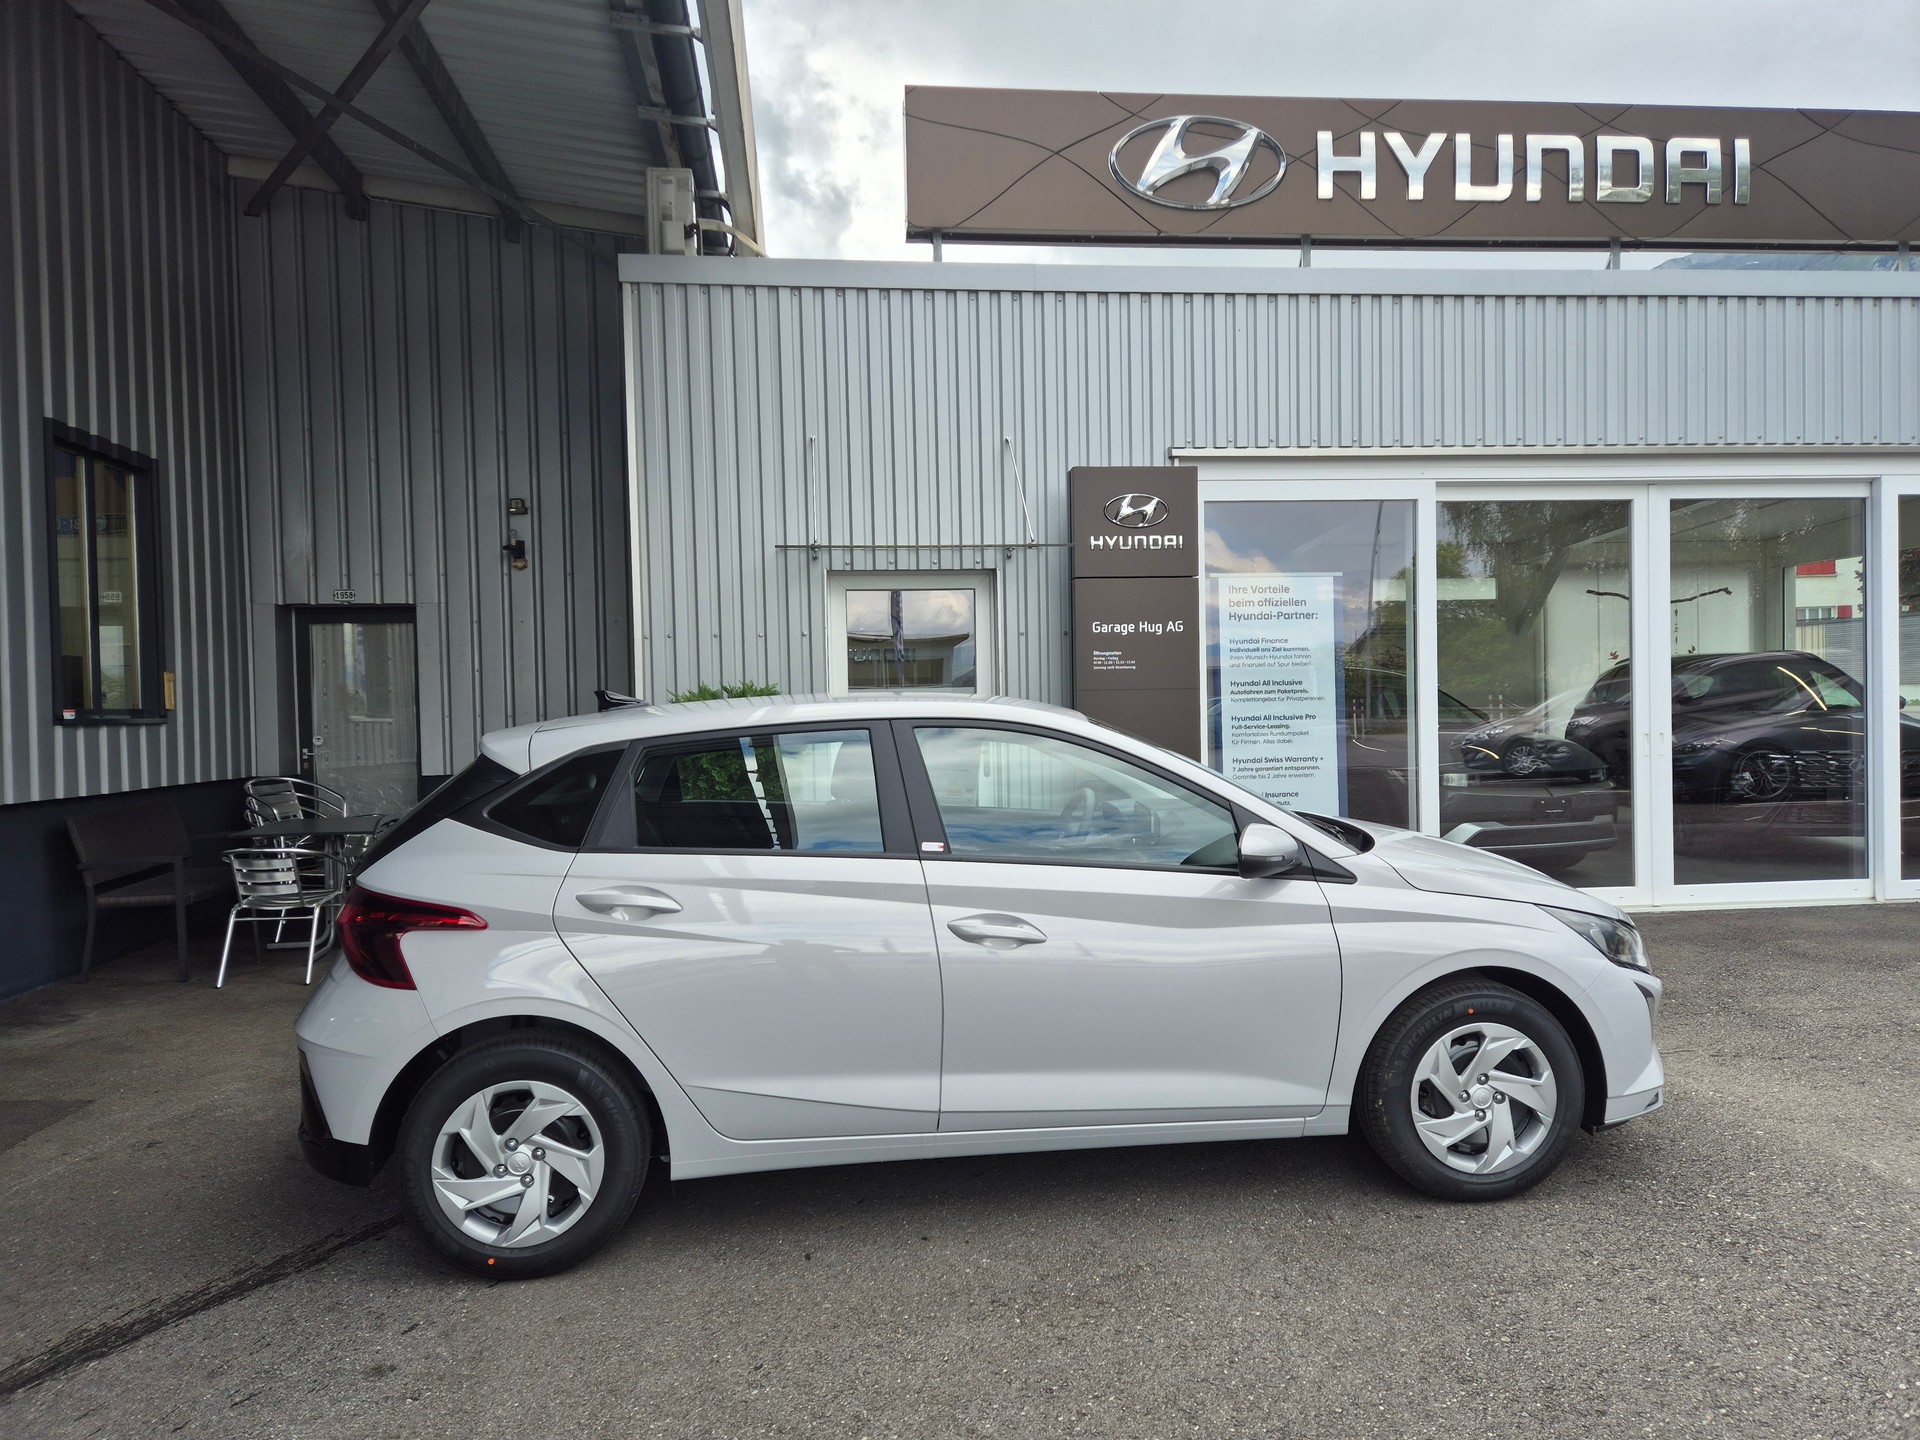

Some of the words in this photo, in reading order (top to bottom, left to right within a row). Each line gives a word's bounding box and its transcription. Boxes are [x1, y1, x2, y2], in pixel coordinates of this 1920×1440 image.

[1316, 130, 1750, 205] HYUNDAI
[1090, 535, 1183, 550] HYUNDAI
[1228, 585, 1248, 594] Ihre
[1251, 584, 1290, 594] Vorteile
[1228, 598, 1255, 608] beim
[1257, 598, 1307, 607] offiziellen
[1229, 610, 1318, 622] Hyundai-Partner:
[1092, 621, 1135, 635] Garage
[1139, 621, 1163, 635] Hug
[1166, 620, 1184, 632] AG
[1229, 637, 1260, 645] Hyundai
[1230, 680, 1260, 688] Hyundai
[1231, 714, 1262, 722] Hyundai
[1232, 757, 1263, 765] Hyundai
[1285, 756, 1318, 764] Warranty
